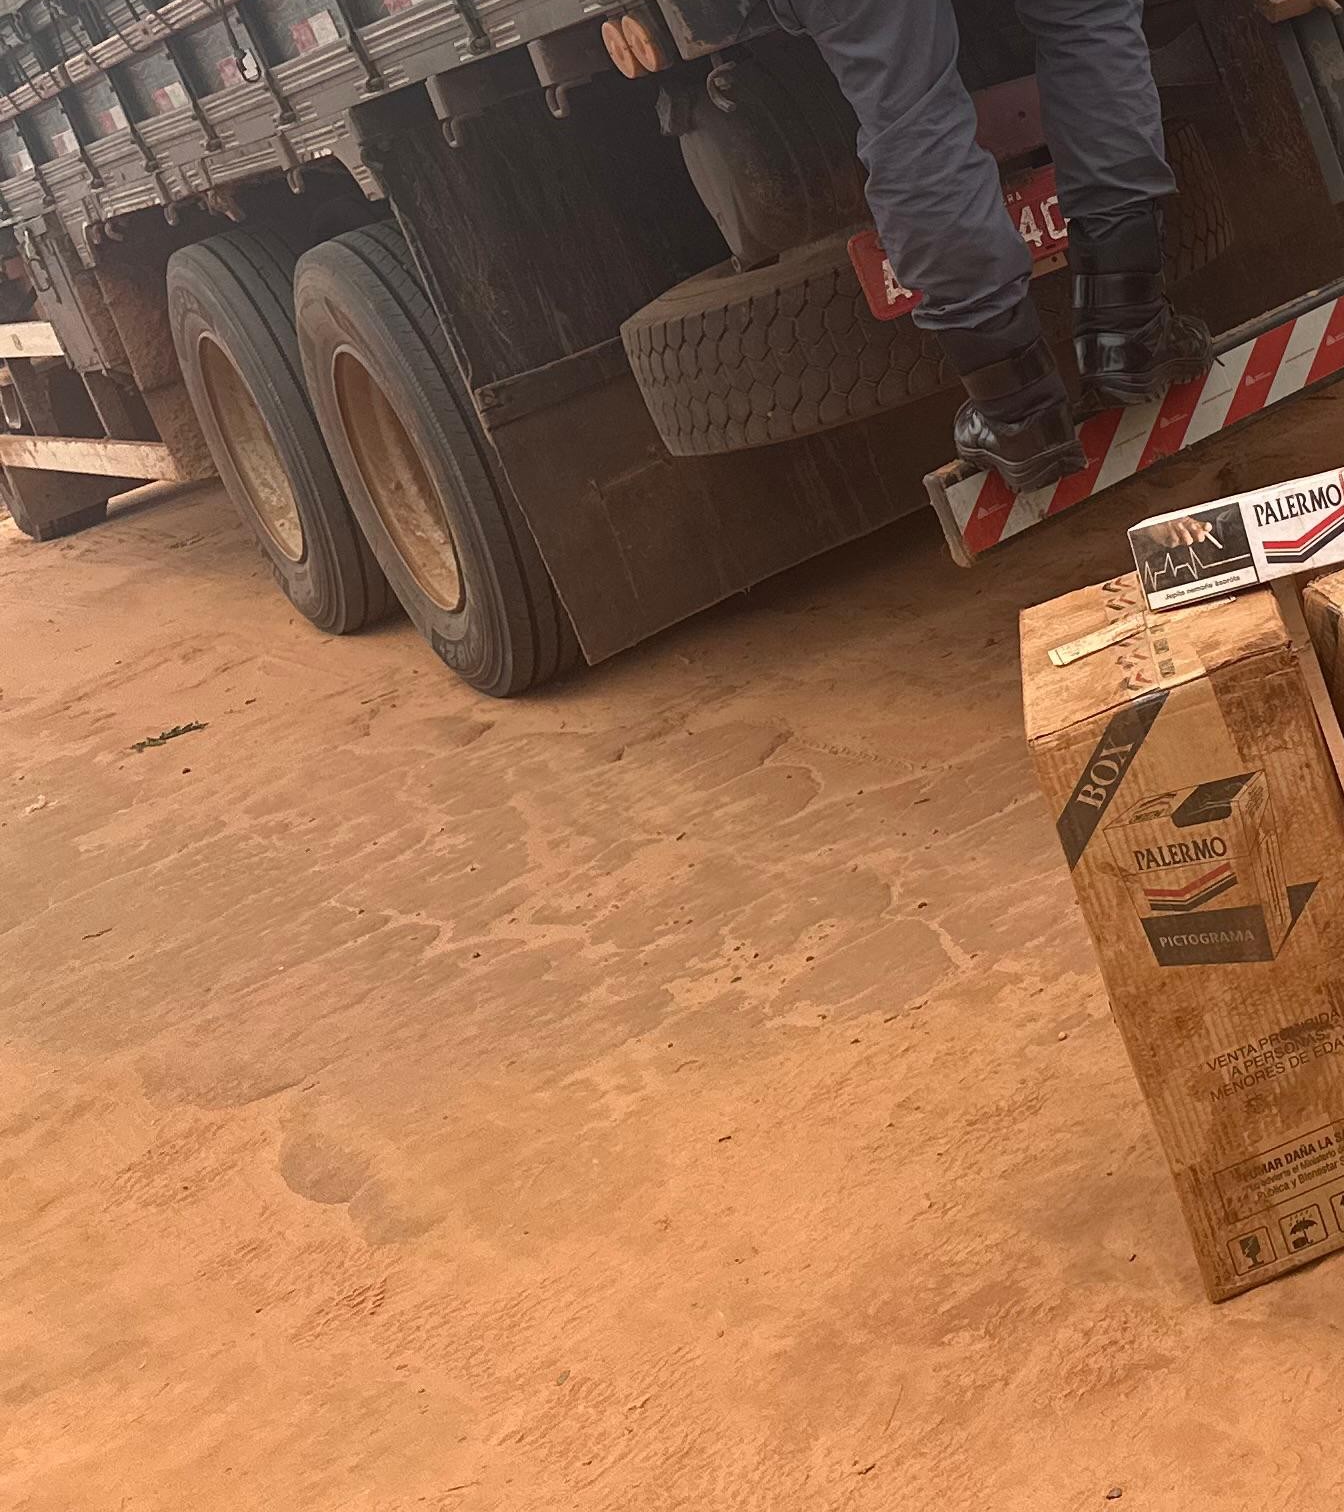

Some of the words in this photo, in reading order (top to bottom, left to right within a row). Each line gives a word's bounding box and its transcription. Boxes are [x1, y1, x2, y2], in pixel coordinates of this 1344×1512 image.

[1253, 483, 1342, 528] PALERMO
[1075, 735, 1136, 809] BOX
[1133, 837, 1227, 870] PALERMO
[1160, 929, 1254, 948] PICTOGRAMA
[1206, 1045, 1258, 1072] VENTA
[1231, 1066, 1245, 1078] A
[1244, 1028, 1326, 1072] PERSONAS
[1209, 1061, 1285, 1103] MENORES
[1289, 1052, 1311, 1069] DE
[1285, 1143, 1317, 1165] DAÑA
[1317, 1136, 1333, 1149] LA
